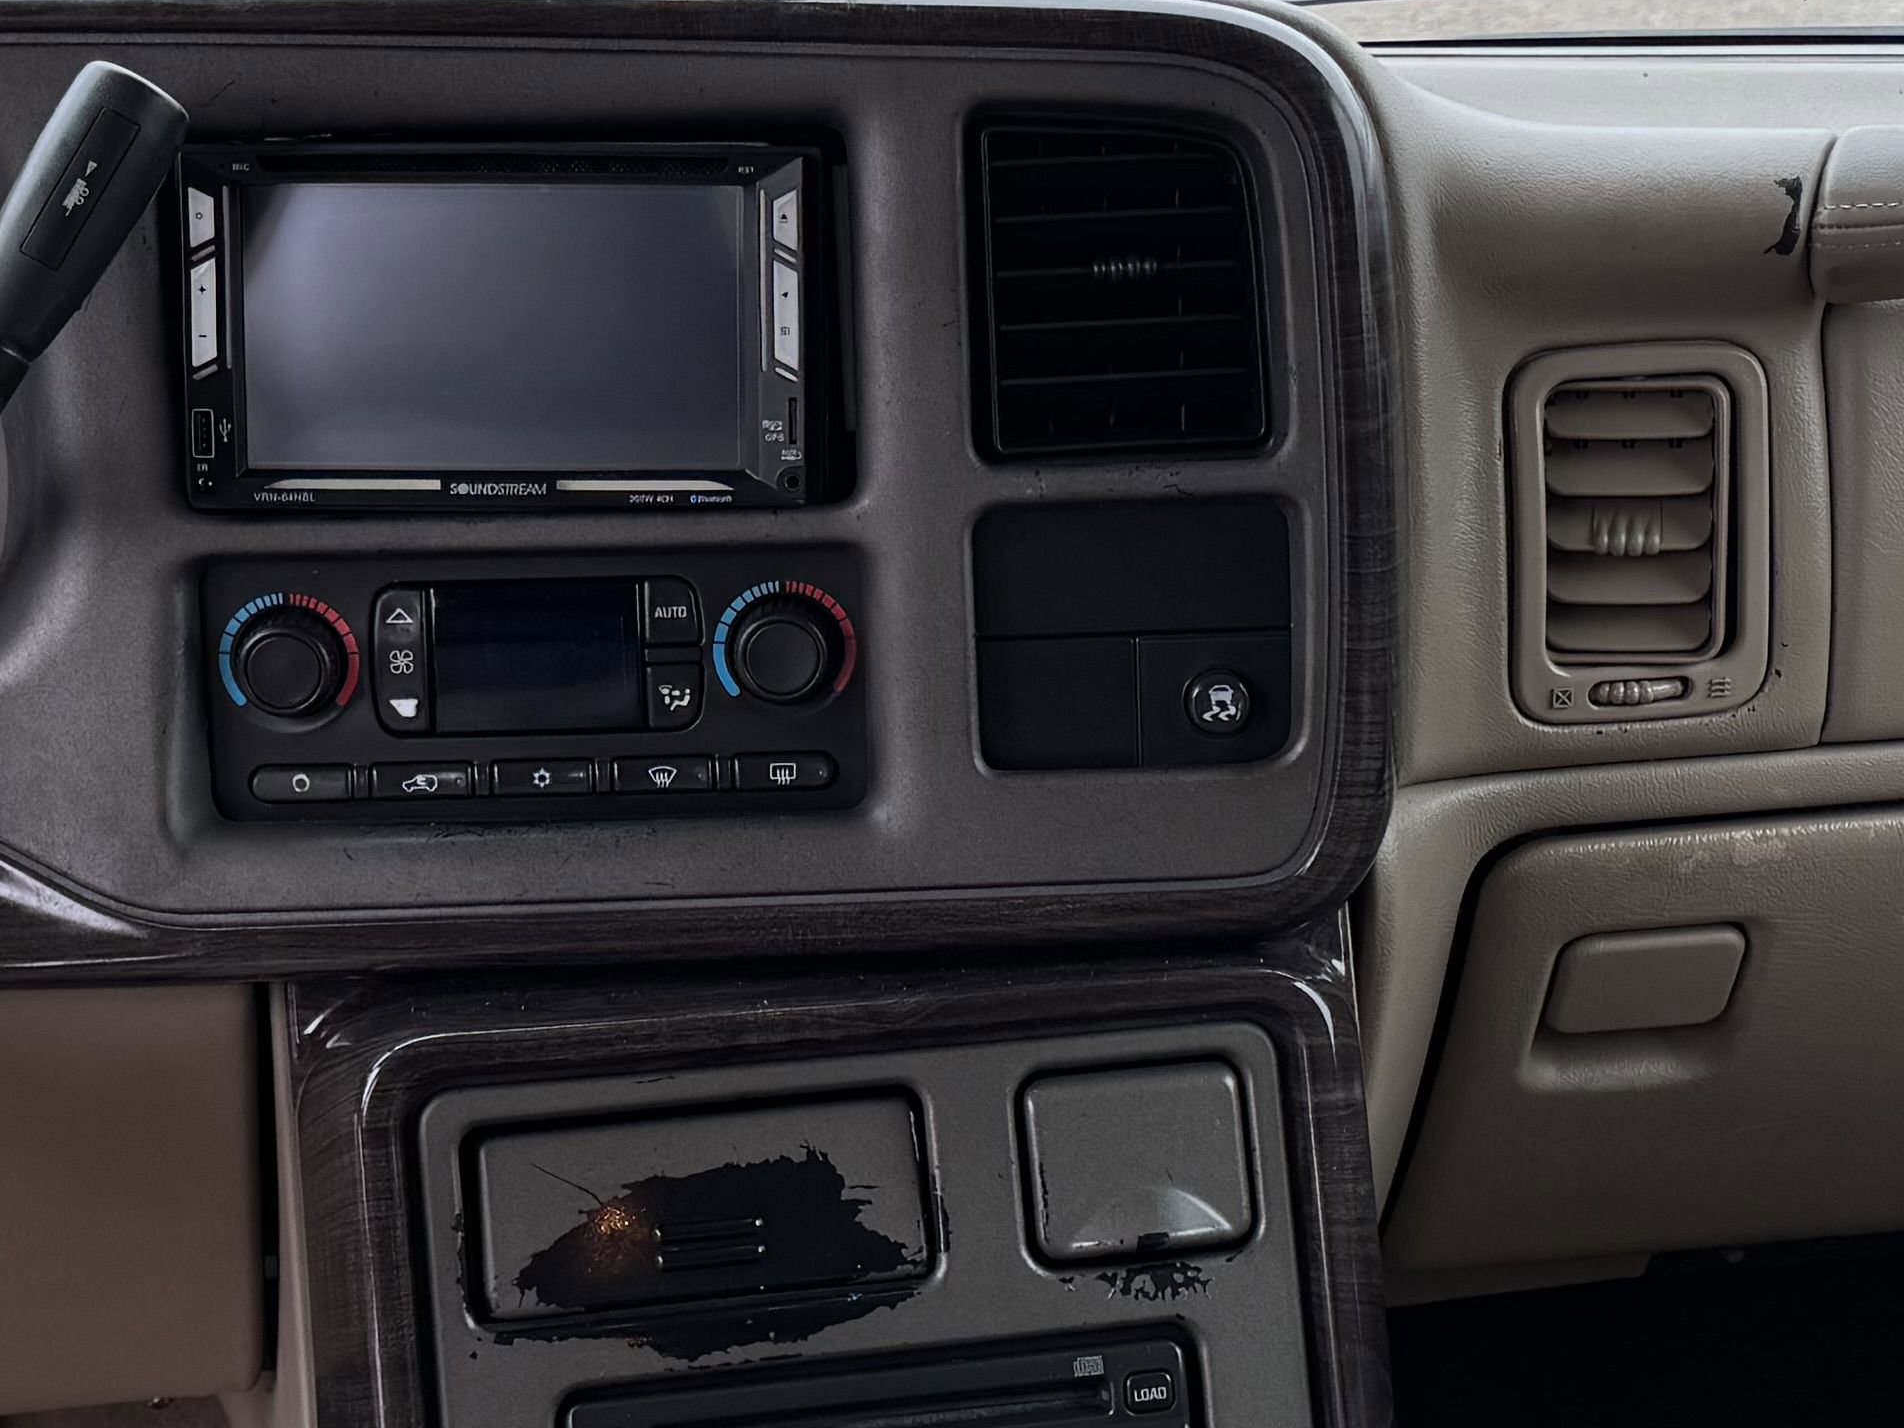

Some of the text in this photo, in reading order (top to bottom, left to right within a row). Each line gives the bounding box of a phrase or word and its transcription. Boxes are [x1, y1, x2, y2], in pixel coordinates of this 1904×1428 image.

[450, 483, 547, 496] SOUNDSTREAM
[654, 606, 687, 619] AUTO
[1134, 1386, 1167, 1402] LOAD
